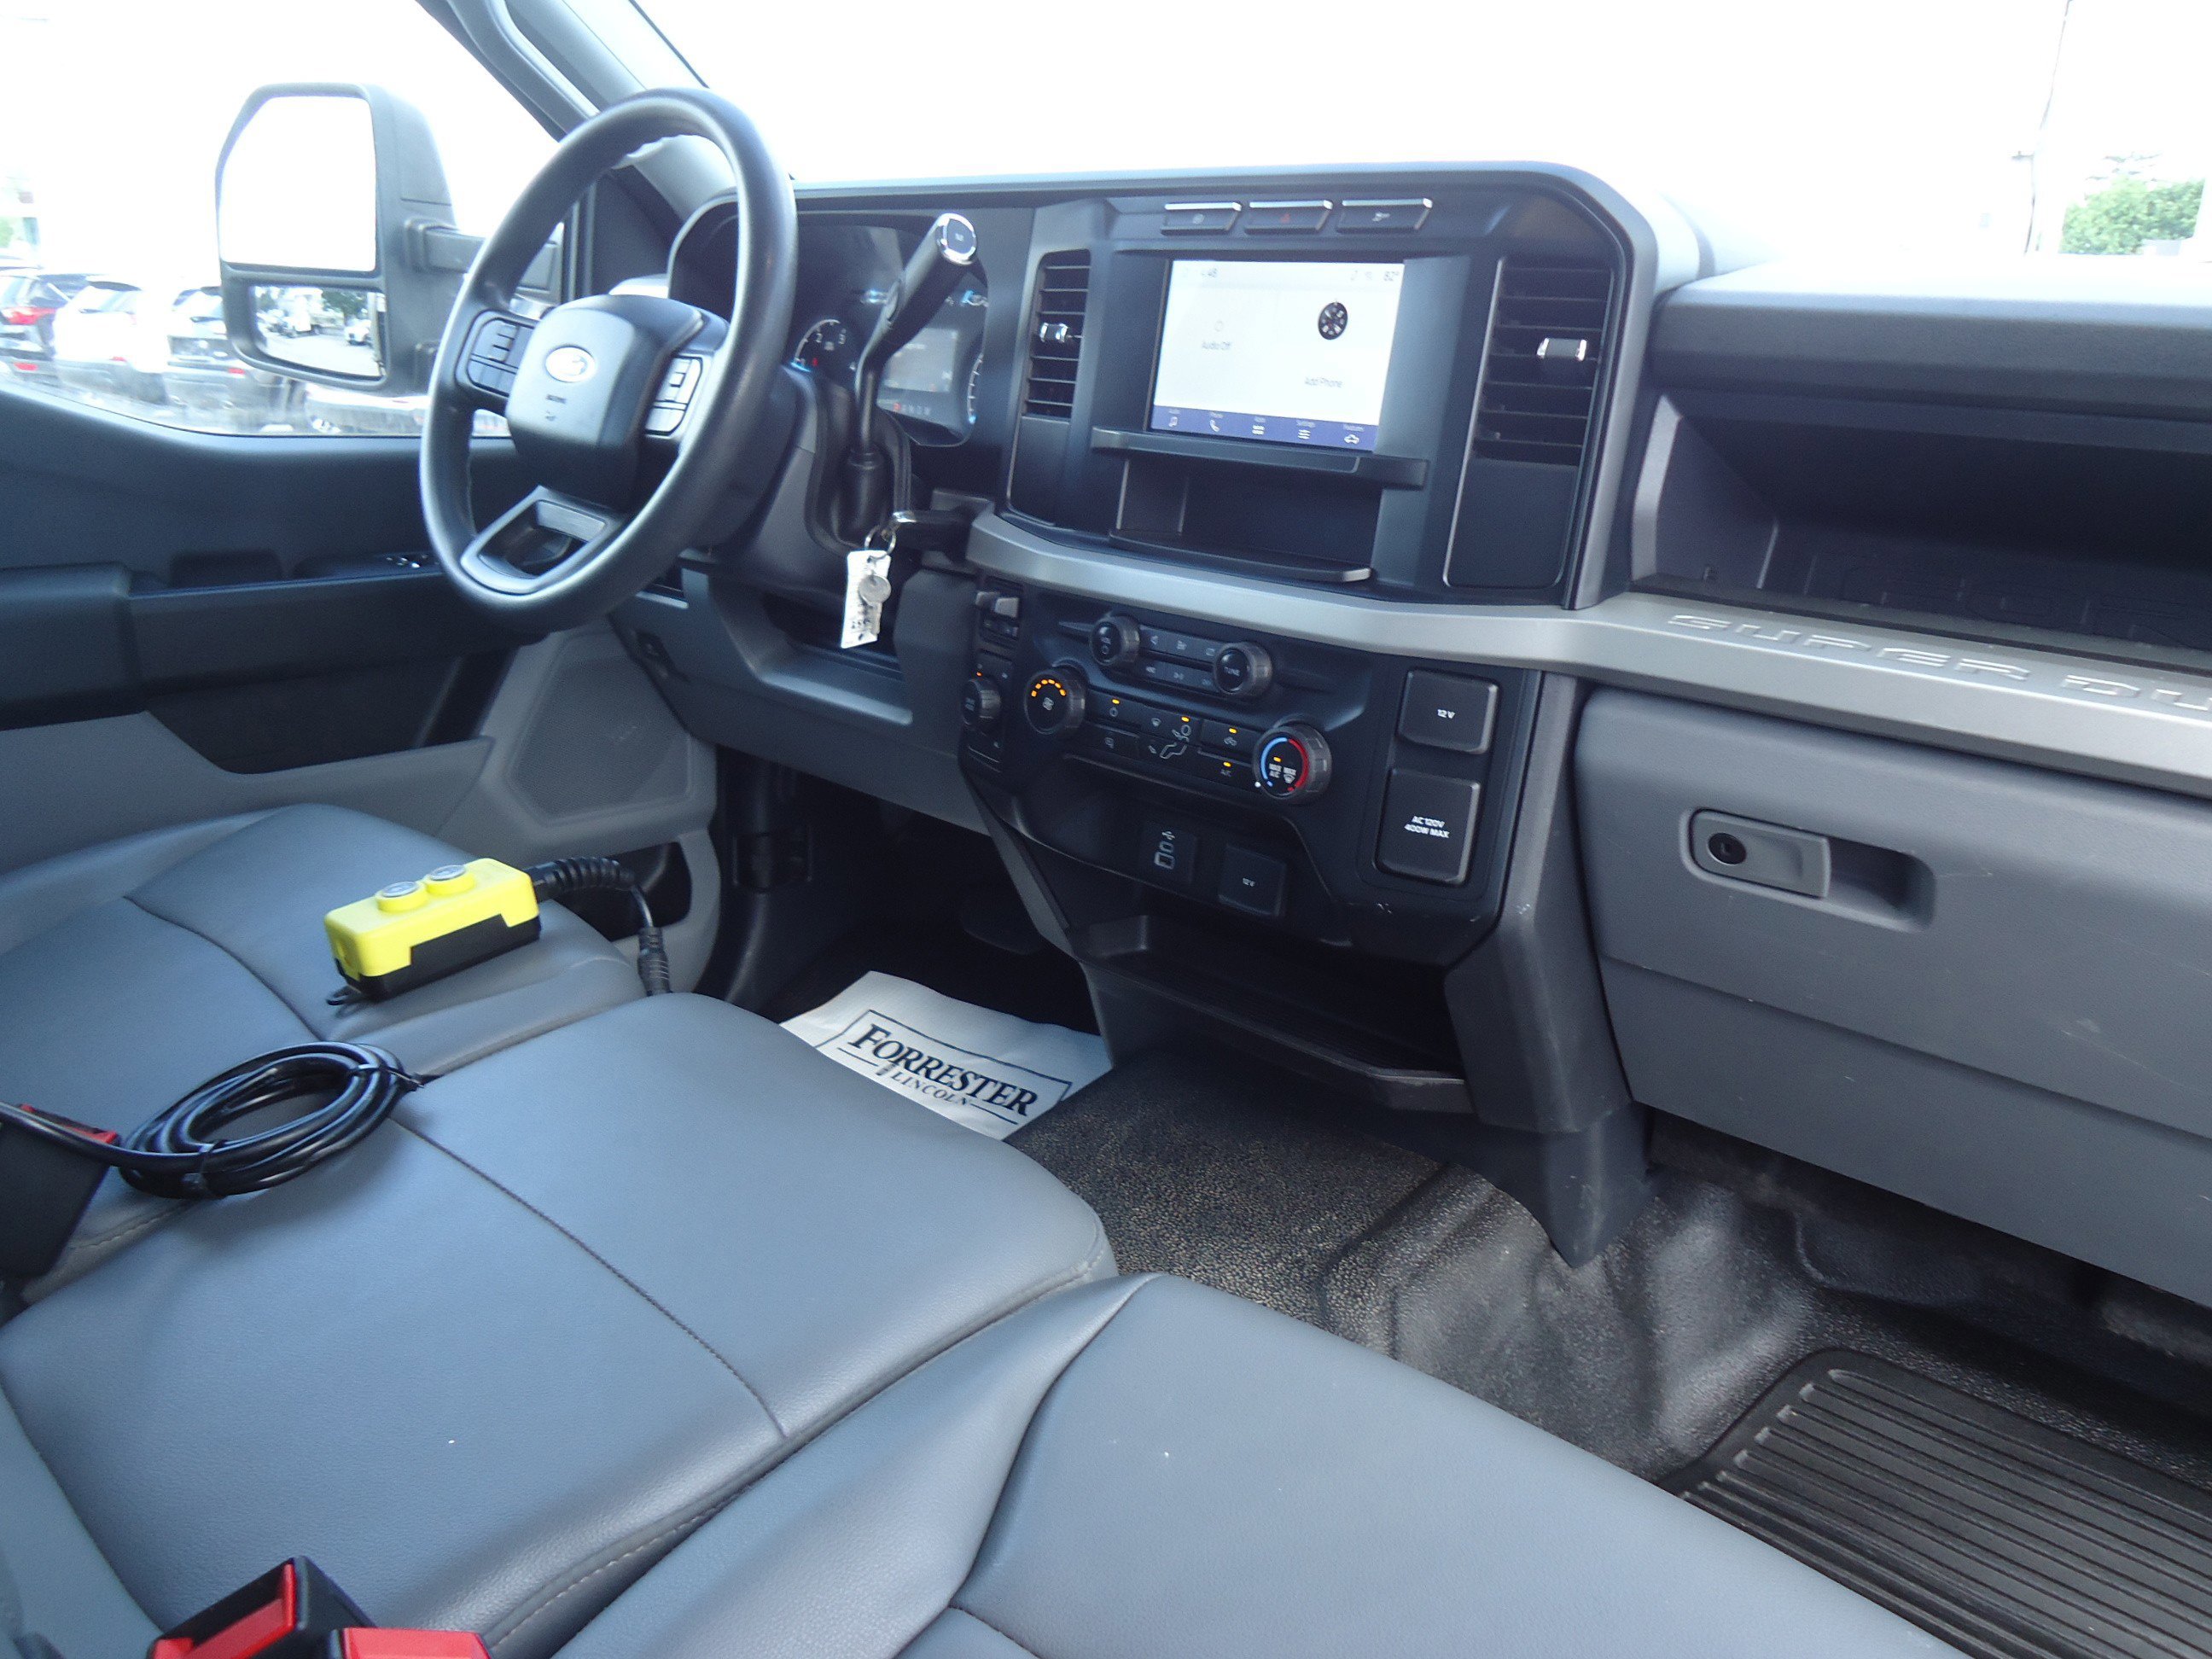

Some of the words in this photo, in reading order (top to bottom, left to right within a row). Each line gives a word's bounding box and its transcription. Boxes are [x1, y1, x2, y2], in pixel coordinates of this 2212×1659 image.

[1668, 614, 2031, 681] SUPER
[1404, 824, 1429, 835] 400W
[1429, 828, 1450, 839] MAX
[847, 1023, 1039, 1116] FORRESTER
[891, 1073, 973, 1106] LINCOLN
